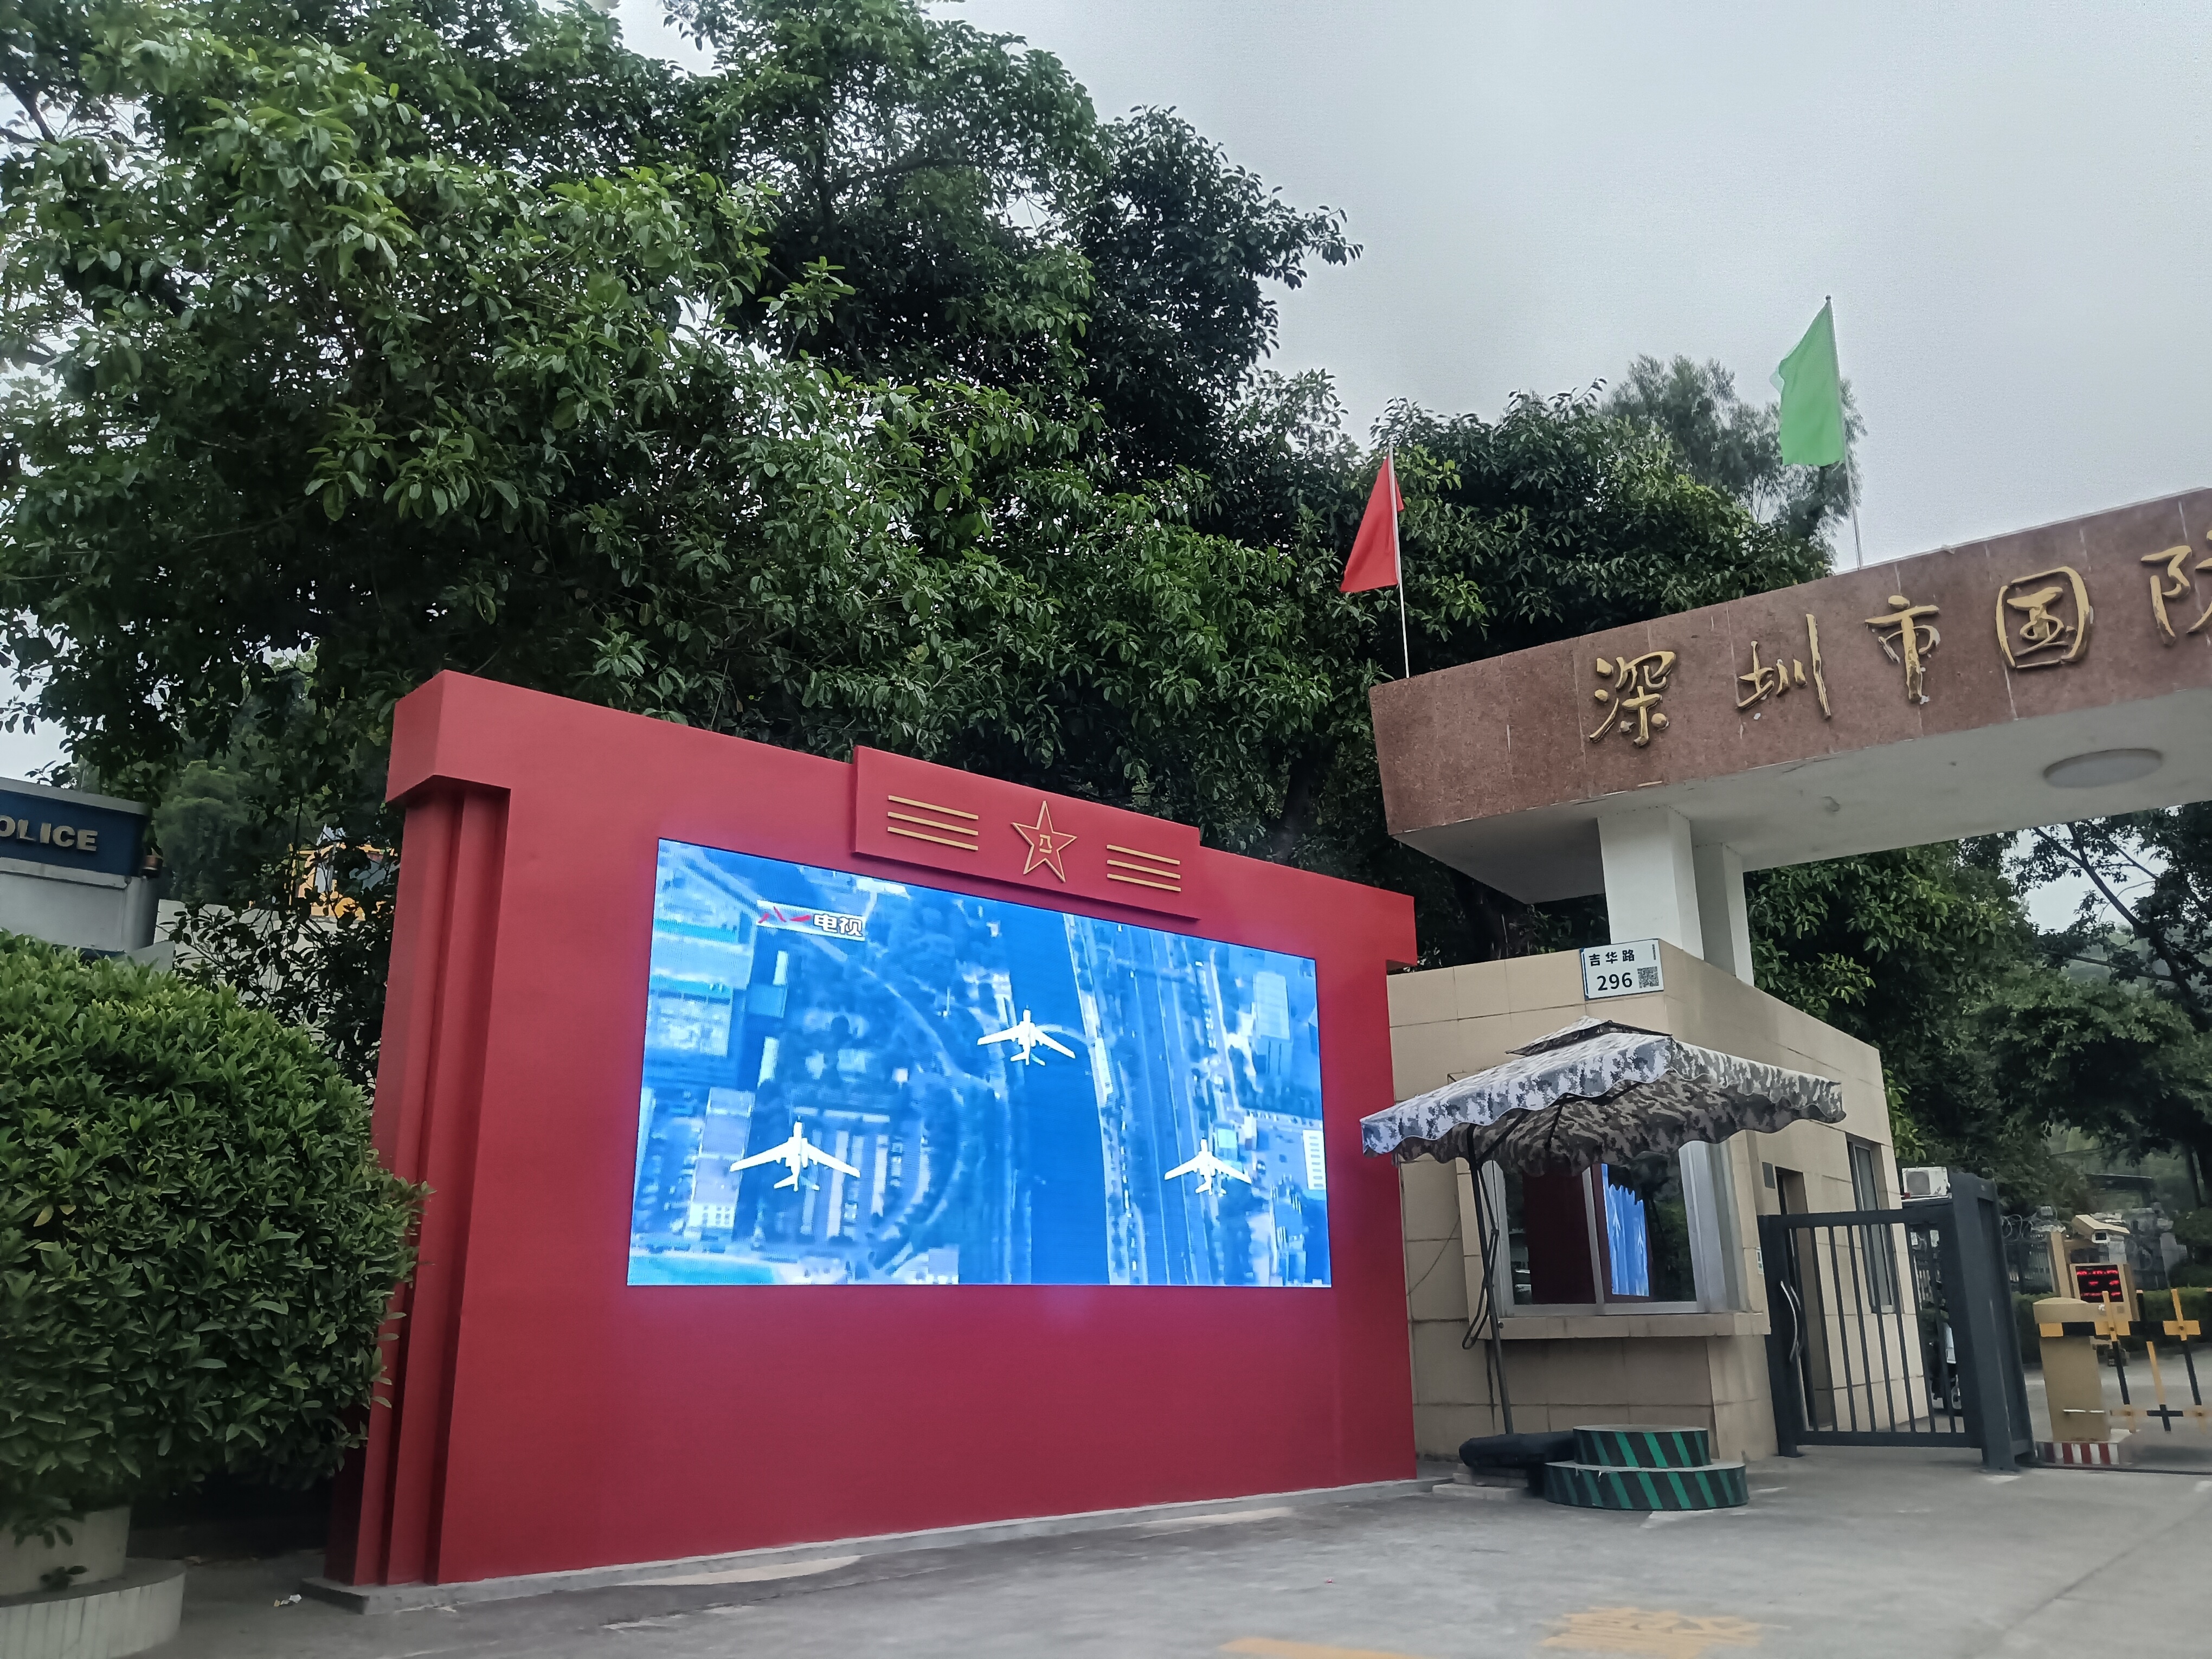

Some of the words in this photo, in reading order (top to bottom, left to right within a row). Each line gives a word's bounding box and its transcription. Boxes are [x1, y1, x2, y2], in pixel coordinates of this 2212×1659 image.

[1589, 949, 1635, 967] 吉华路
[1597, 972, 1632, 991] 296
